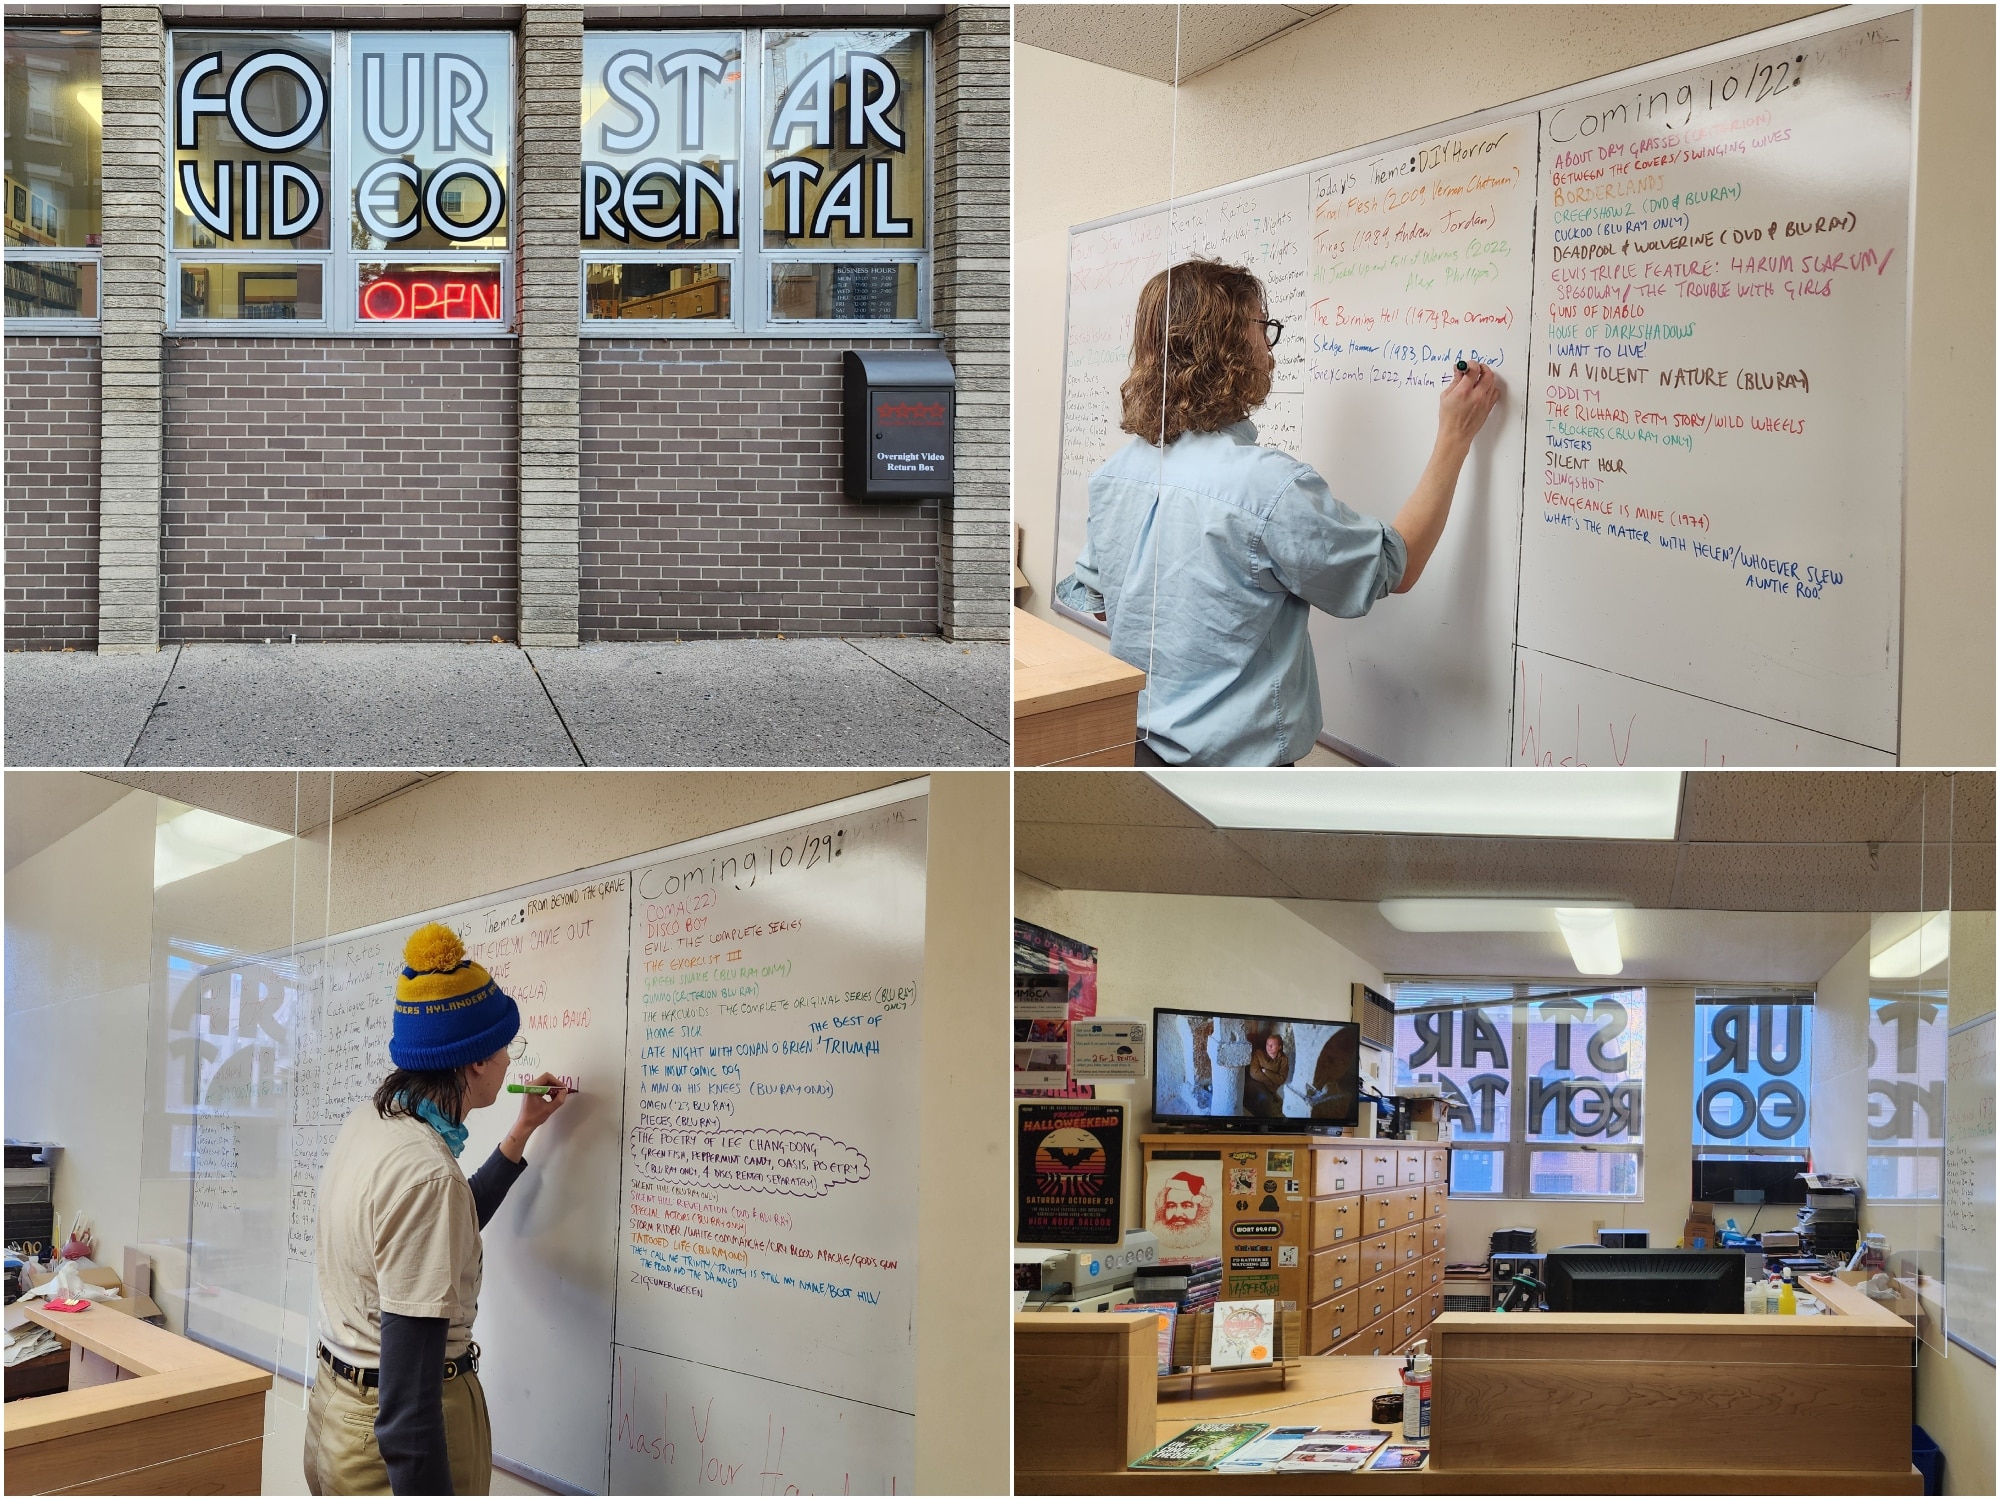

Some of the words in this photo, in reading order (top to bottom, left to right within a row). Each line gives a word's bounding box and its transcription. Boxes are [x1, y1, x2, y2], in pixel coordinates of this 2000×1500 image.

[1549, 84, 1692, 143] Coming
[1553, 168, 1604, 186] BETWEEN
[1609, 161, 1628, 178] THE
[1751, 129, 1791, 150] WIVES
[1555, 150, 1594, 169] ABOUT
[1598, 143, 1624, 162] DRY
[1629, 132, 1681, 158] GRASSES
[1314, 173, 1357, 199] Today's
[1452, 132, 1509, 164] Horror
[1553, 175, 1664, 208] BORDERLANDS
[1314, 229, 1345, 260] Things
[1440, 204, 1497, 234] Jordan)
[1653, 212, 1689, 232] ONLY)
[1553, 240, 1616, 263] DEADPOOL
[1634, 231, 1714, 255] WOLVERINE
[1551, 263, 1588, 282] ELVIS
[1589, 262, 1636, 280] TRIPLE
[1644, 260, 1719, 278] FEATURE:
[1731, 255, 1793, 274] HARUM
[364, 280, 498, 320] OPEN
[1675, 279, 1730, 298] TROUBLE
[1737, 280, 1775, 298] WITH
[1784, 278, 1833, 303] GIRLS
[1549, 302, 1577, 321] GUNS
[1583, 304, 1598, 317] OF
[1602, 304, 1644, 319] DIABLO
[1549, 323, 1579, 339] HOUSE
[1585, 324, 1598, 338] OF
[1422, 345, 1451, 362] David
[1558, 344, 1590, 357] WANT
[1595, 346, 1612, 358] TO
[1618, 341, 1647, 359] LIVE!
[1548, 362, 1561, 378] IN
[1569, 363, 1579, 379] A
[1586, 365, 1649, 384] VIOLENT
[1660, 368, 1728, 388] NATURE
[1546, 386, 1600, 402] ODDITY
[1546, 401, 1570, 418] THE
[1575, 404, 1629, 424] RICHARD
[1634, 409, 1668, 426] PETTY
[1751, 416, 1806, 435] WHEELS
[1546, 420, 1606, 441] T-BLOCKERS
[1662, 432, 1692, 452] ONLY)
[1546, 435, 1592, 451] TWISTERS
[877, 452, 919, 462] Overnight
[921, 452, 945, 460] Video
[887, 463, 916, 471] Return
[919, 463, 934, 471] Box
[1545, 451, 1589, 471] SILENT
[1598, 458, 1628, 474] HOUR
[1545, 471, 1604, 492] SLINGSHOT
[1544, 491, 1614, 516] VENGEANCE
[1619, 502, 1630, 518] IS
[1636, 506, 1664, 524] MINE
[1671, 510, 1710, 532] (1974)
[1544, 511, 1580, 531] WHAT'S
[1584, 519, 1601, 535] THE
[1608, 524, 1650, 544] MATTER
[1659, 535, 1686, 551] WITH
[1806, 565, 1844, 586] SLEW
[1745, 574, 1790, 593] AUNTIE
[639, 851, 757, 900] Coming
[483, 908, 526, 935] Theme:
[527, 898, 548, 917] FROM
[551, 889, 580, 911] BEYOND
[582, 885, 597, 900] THE
[598, 878, 625, 899] GRAVE
[567, 920, 594, 941] OUT
[647, 920, 680, 939] DISCO
[686, 917, 708, 932] BOY
[677, 935, 704, 948] THE
[710, 925, 763, 944] COMPLETE
[768, 918, 802, 934] SERIES
[644, 960, 665, 973] THE
[670, 954, 721, 971] EXORCIST
[727, 949, 742, 962] III
[426, 991, 487, 1014] HYLANDERS
[740, 998, 789, 1015] COMPLETE
[793, 993, 840, 1010] ORIGINAL
[844, 990, 872, 1002] SERIES
[528, 1014, 558, 1030] MARIO
[562, 1008, 592, 1028] BAVA)
[808, 1020, 829, 1033] THE
[832, 1015, 865, 1028] BEST
[867, 1015, 883, 1028] OF
[646, 1025, 675, 1041] HOME
[681, 1025, 702, 1038] SICK
[640, 1046, 666, 1060] LATE
[672, 1046, 704, 1061] NIGHT
[710, 1045, 732, 1058] WITH
[735, 1041, 769, 1057] CONAN
[821, 1037, 881, 1057] TRIUMPH
[640, 1064, 660, 1077] THE
[722, 1064, 741, 1080] DOG
[640, 1081, 646, 1094] A
[651, 1082, 668, 1093] MAN
[671, 1082, 682, 1093] ON
[687, 1083, 701, 1093] HIS
[708, 1083, 741, 1095] KNEES
[640, 1113, 672, 1127] PIECES
[1023, 1117, 1119, 1131] HALLOWEEKEND
[637, 1131, 654, 1145] THE
[661, 1133, 696, 1145] POETRY
[704, 1137, 716, 1148] OF
[722, 1137, 743, 1149] LEE
[749, 1139, 818, 1156] CHANG-DONG
[691, 1152, 742, 1164] PEPPERMINT
[777, 1158, 809, 1172] OASIS,
[813, 1161, 858, 1175] POETRY
[702, 1165, 710, 1178] 4
[677, 1198, 728, 1214] REVELATION
[1026, 1196, 1065, 1205] SATURDAY
[1068, 1197, 1101, 1205] OCTOBER
[618, 1355, 675, 1464] Wash
[691, 1396, 744, 1486] Your
